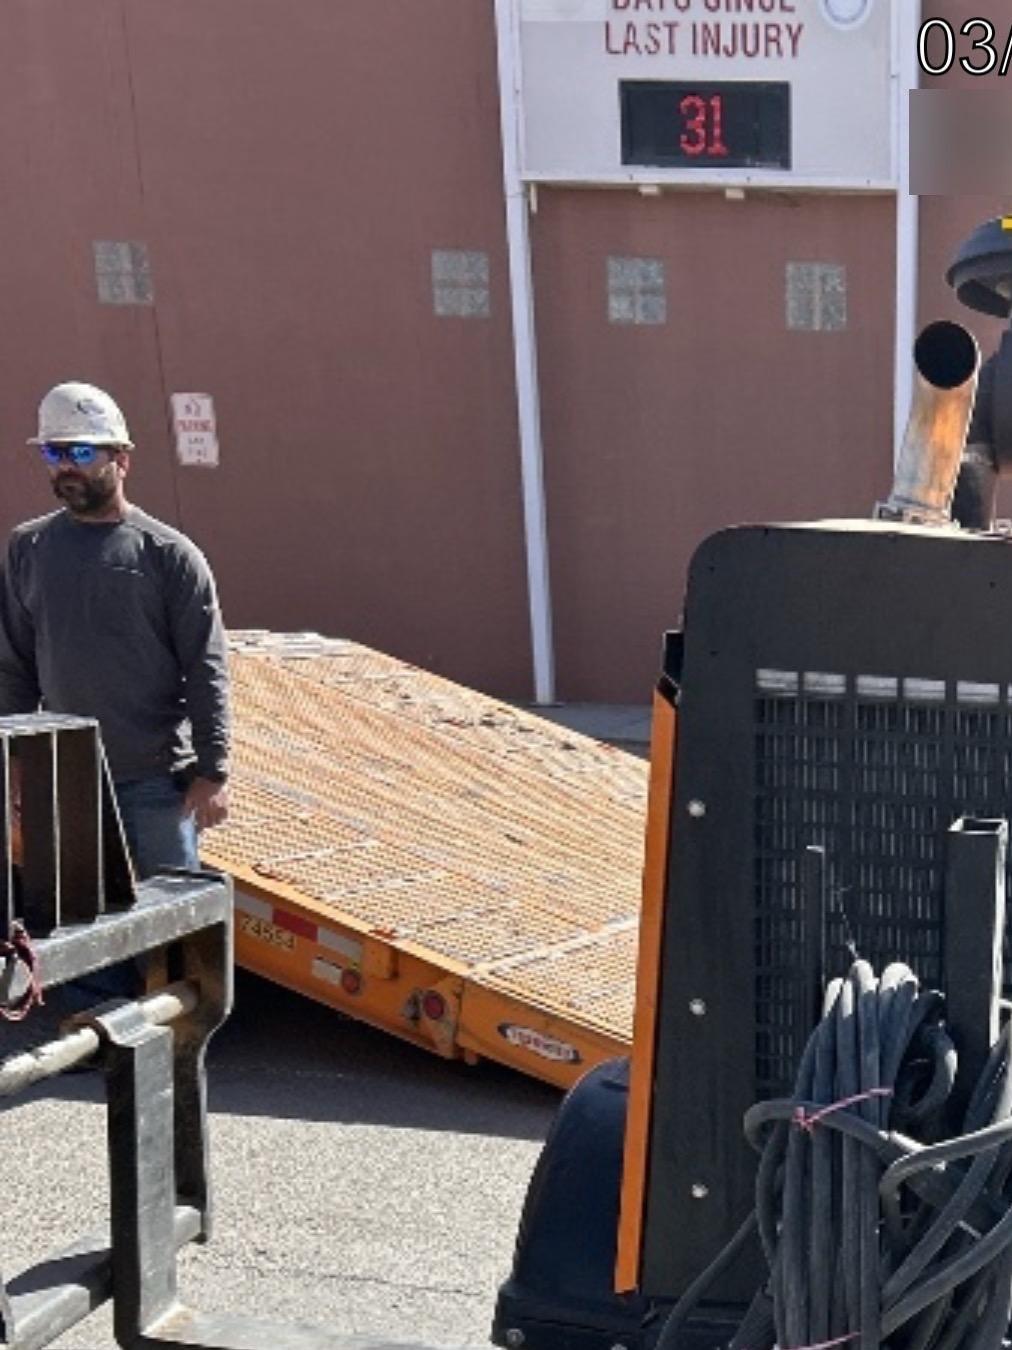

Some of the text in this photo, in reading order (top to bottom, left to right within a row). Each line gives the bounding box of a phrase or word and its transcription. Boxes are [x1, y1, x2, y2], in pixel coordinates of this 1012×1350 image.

[604, 21, 804, 58] LAST INJURY
[679, 95, 729, 156] 31
